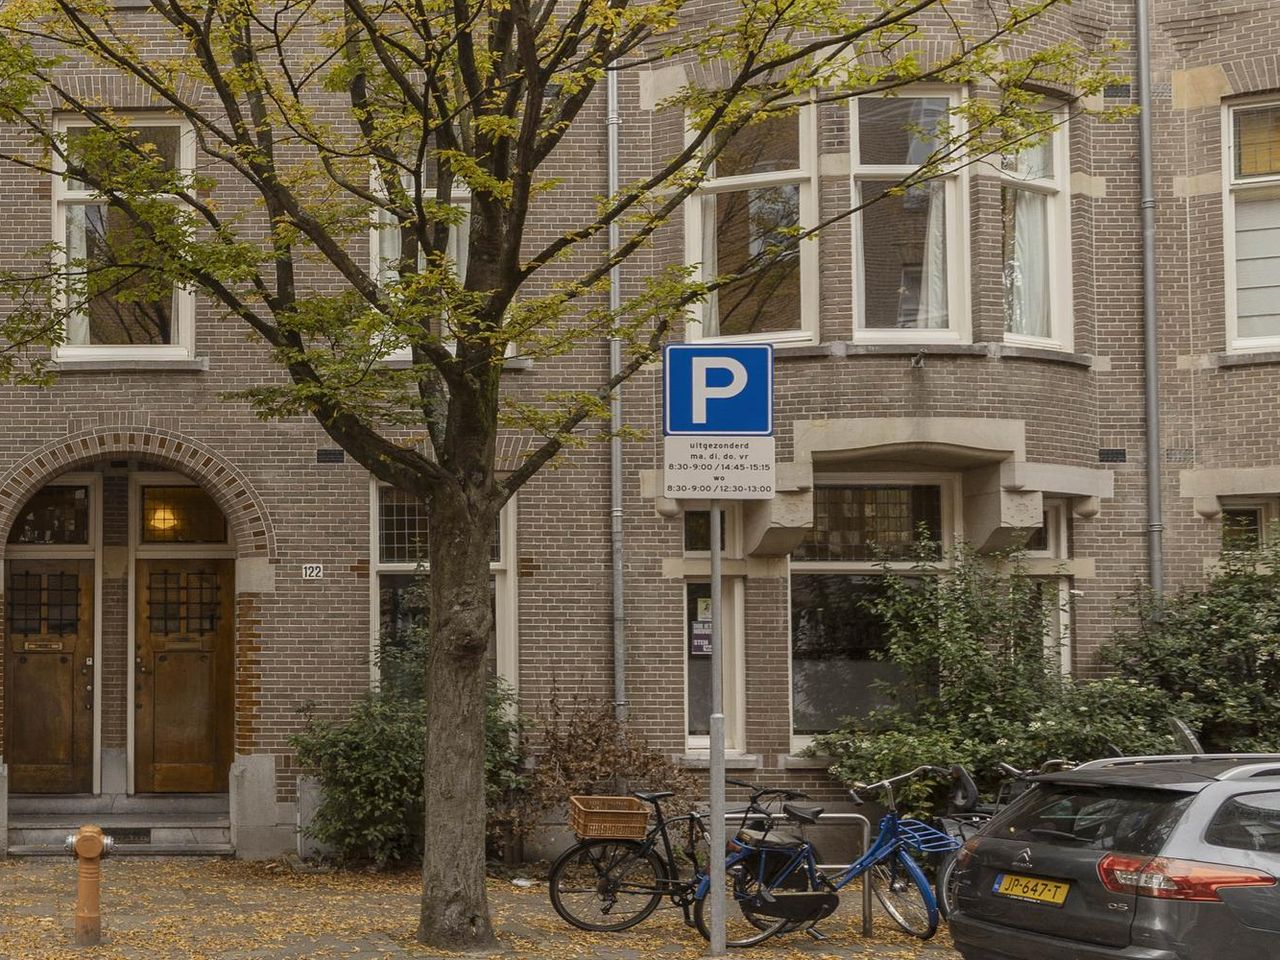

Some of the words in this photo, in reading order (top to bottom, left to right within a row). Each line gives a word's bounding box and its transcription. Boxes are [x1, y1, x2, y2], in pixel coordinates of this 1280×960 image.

[692, 356, 748, 424] P
[689, 442, 749, 450] uitgezonderd
[304, 566, 321, 578] 122
[1004, 877, 1062, 899] JP-647-T
